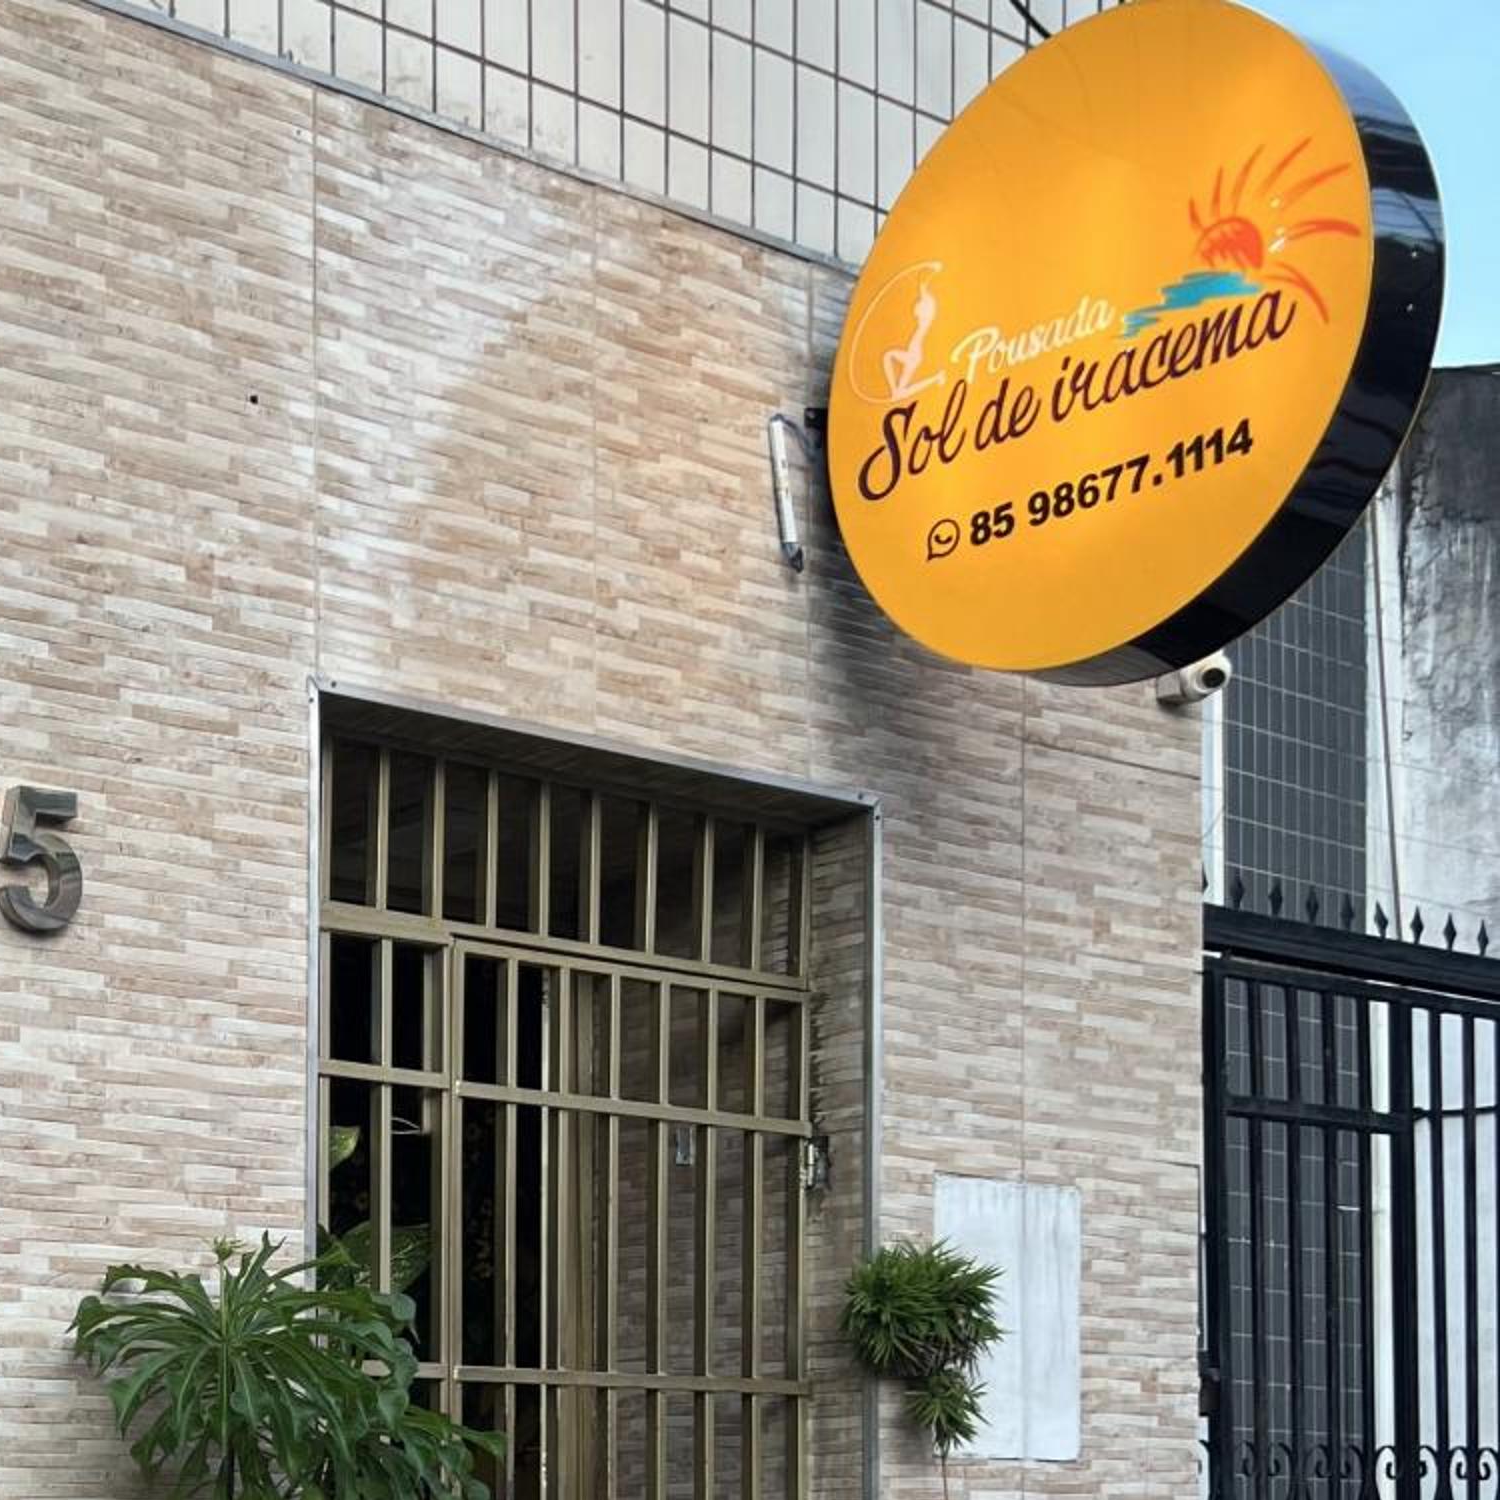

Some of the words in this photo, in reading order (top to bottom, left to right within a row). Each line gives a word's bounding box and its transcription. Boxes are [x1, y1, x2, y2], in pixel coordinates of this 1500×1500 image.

[857, 378, 968, 502] Sol
[974, 377, 1043, 452] de
[1050, 289, 1298, 423] iracema
[950, 295, 1117, 384] Pousada
[969, 501, 1016, 546] 85
[1027, 417, 1254, 527] 98677.1114
